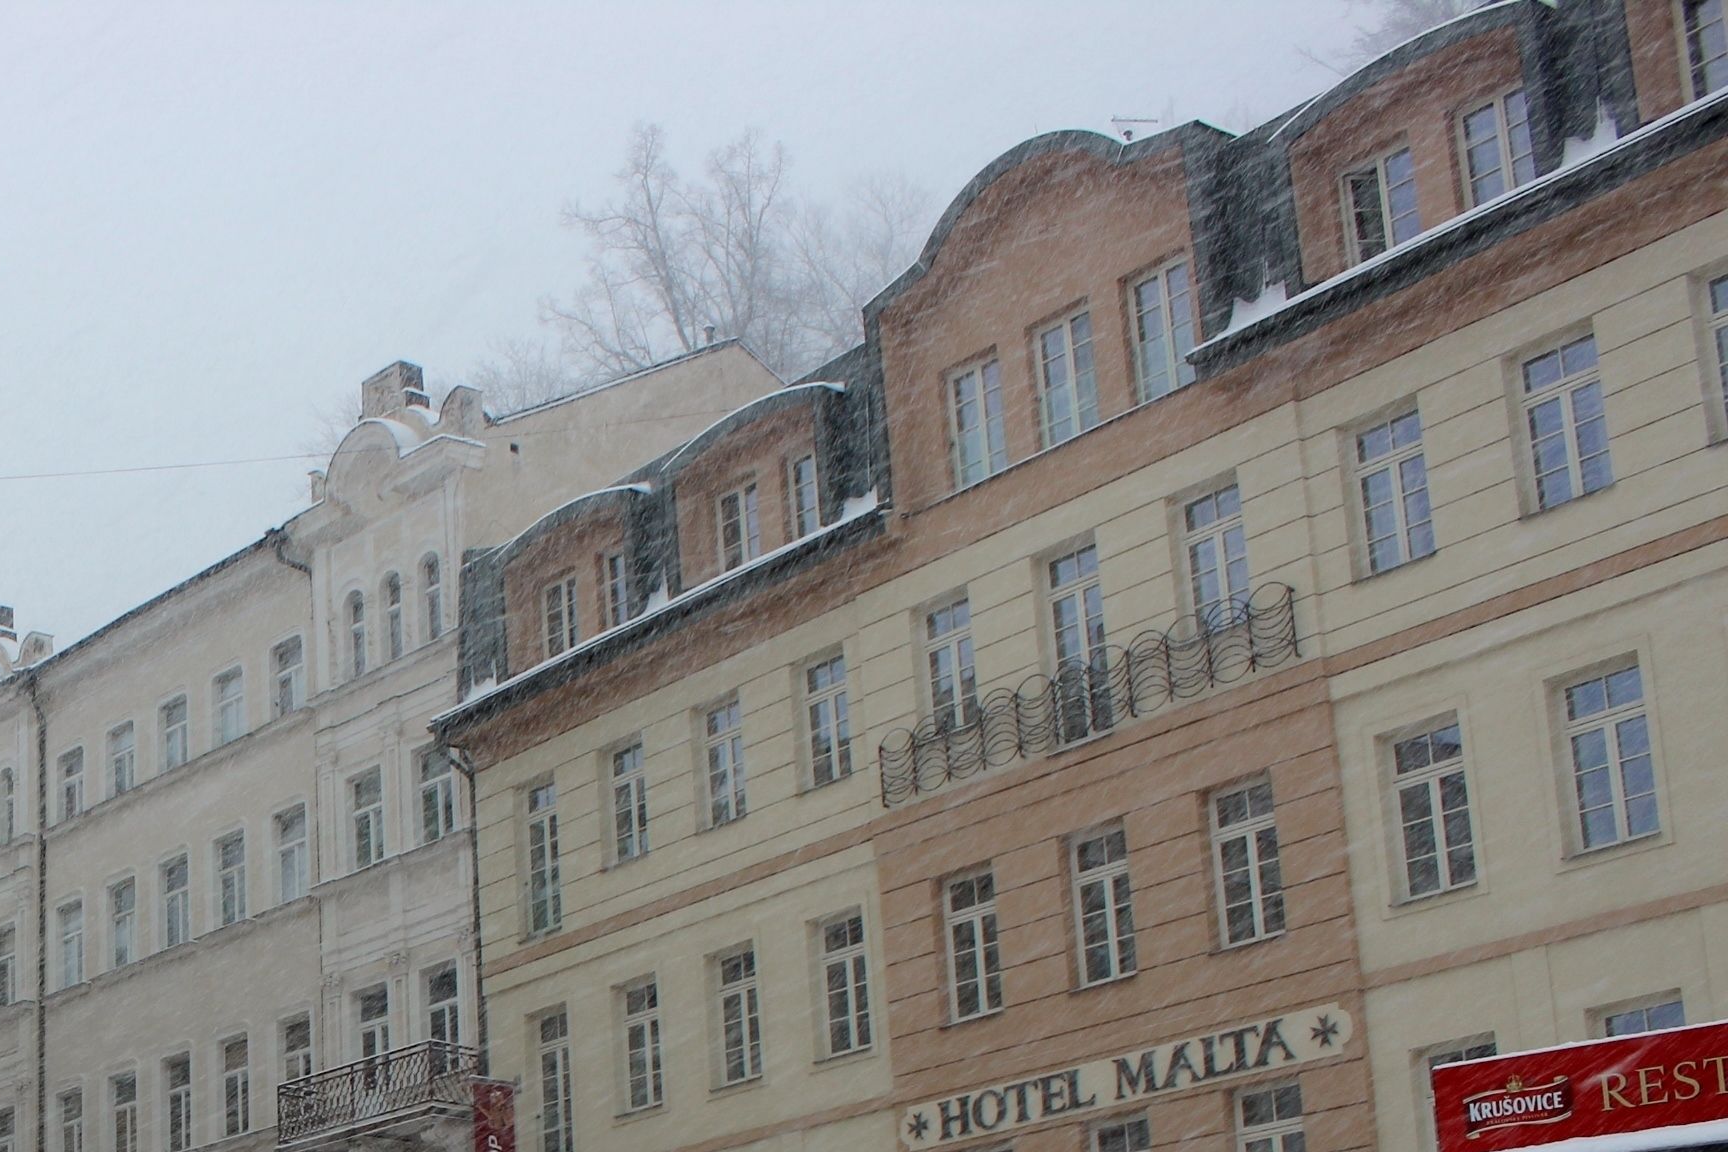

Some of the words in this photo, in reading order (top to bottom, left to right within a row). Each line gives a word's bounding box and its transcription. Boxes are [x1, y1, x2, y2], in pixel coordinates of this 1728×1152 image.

[938, 1068, 1096, 1141] HOTEL
[1114, 1018, 1295, 1099] MALTA
[1469, 1091, 1564, 1122] KRUŠOVICE
